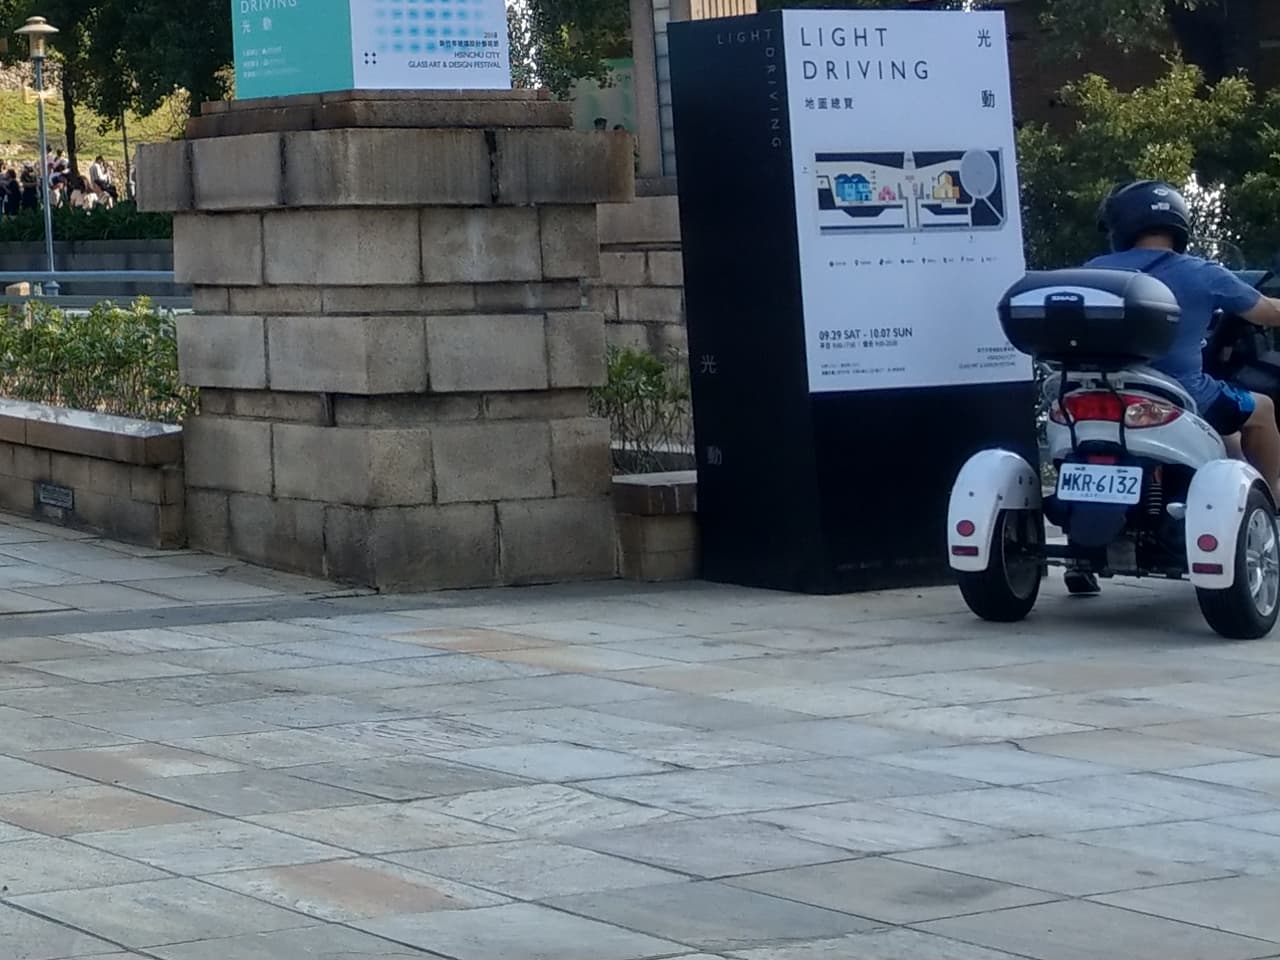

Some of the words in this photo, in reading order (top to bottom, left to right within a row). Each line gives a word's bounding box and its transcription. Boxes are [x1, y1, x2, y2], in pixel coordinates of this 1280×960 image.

[716, 28, 772, 45] LIGHT
[801, 26, 888, 48] LIGHT
[977, 29, 992, 48] 光
[802, 59, 929, 81] DRIVING
[765, 47, 782, 148] DRIVING
[981, 90, 996, 109] 動
[818, 329, 842, 341] 09.29
[843, 328, 861, 340] SAT
[870, 327, 891, 339] 10.07
[892, 326, 913, 338] SUN
[700, 353, 717, 374] 光
